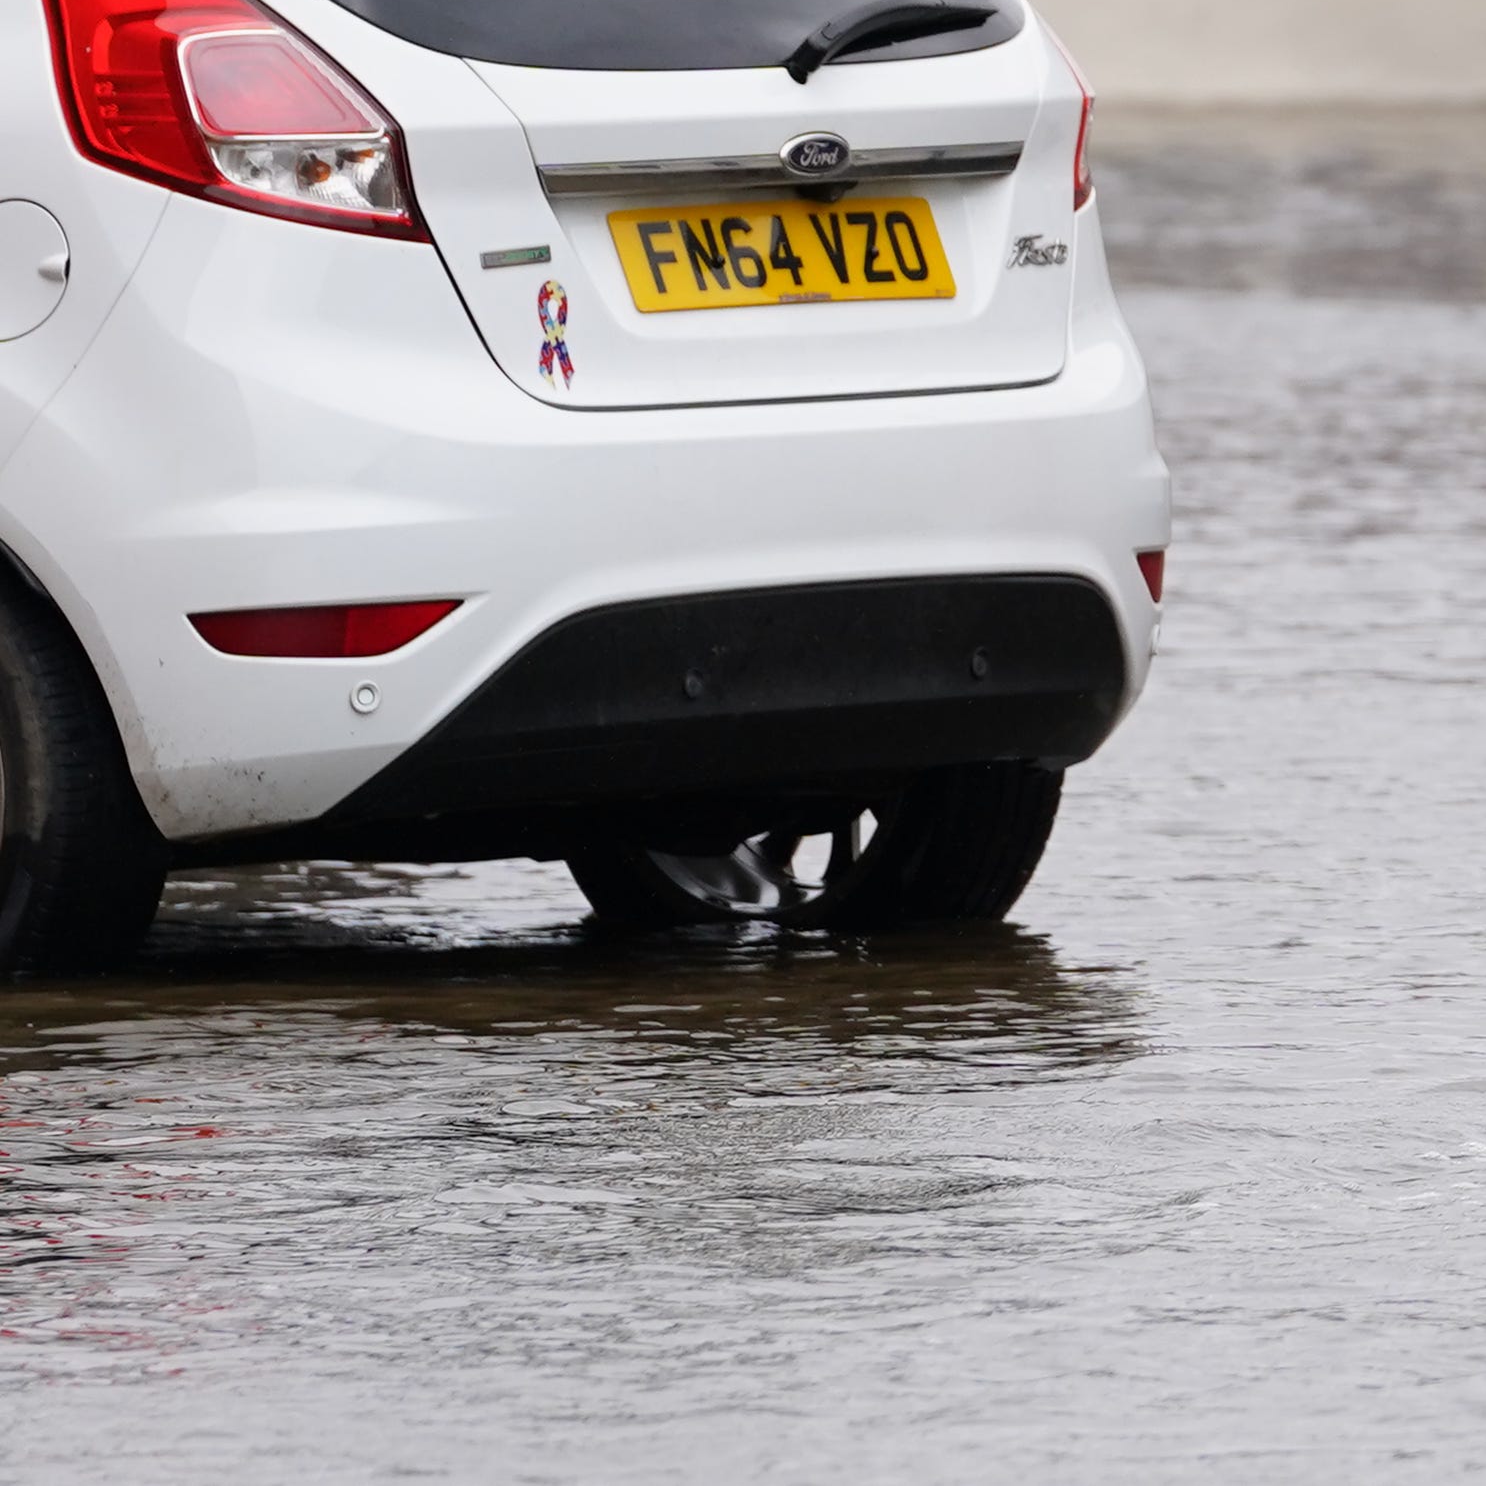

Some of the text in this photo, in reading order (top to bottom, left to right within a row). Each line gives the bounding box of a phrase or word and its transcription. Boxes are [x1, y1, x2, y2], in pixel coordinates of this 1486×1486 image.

[800, 141, 839, 167] Ford
[636, 210, 929, 294] FN64 VZO
